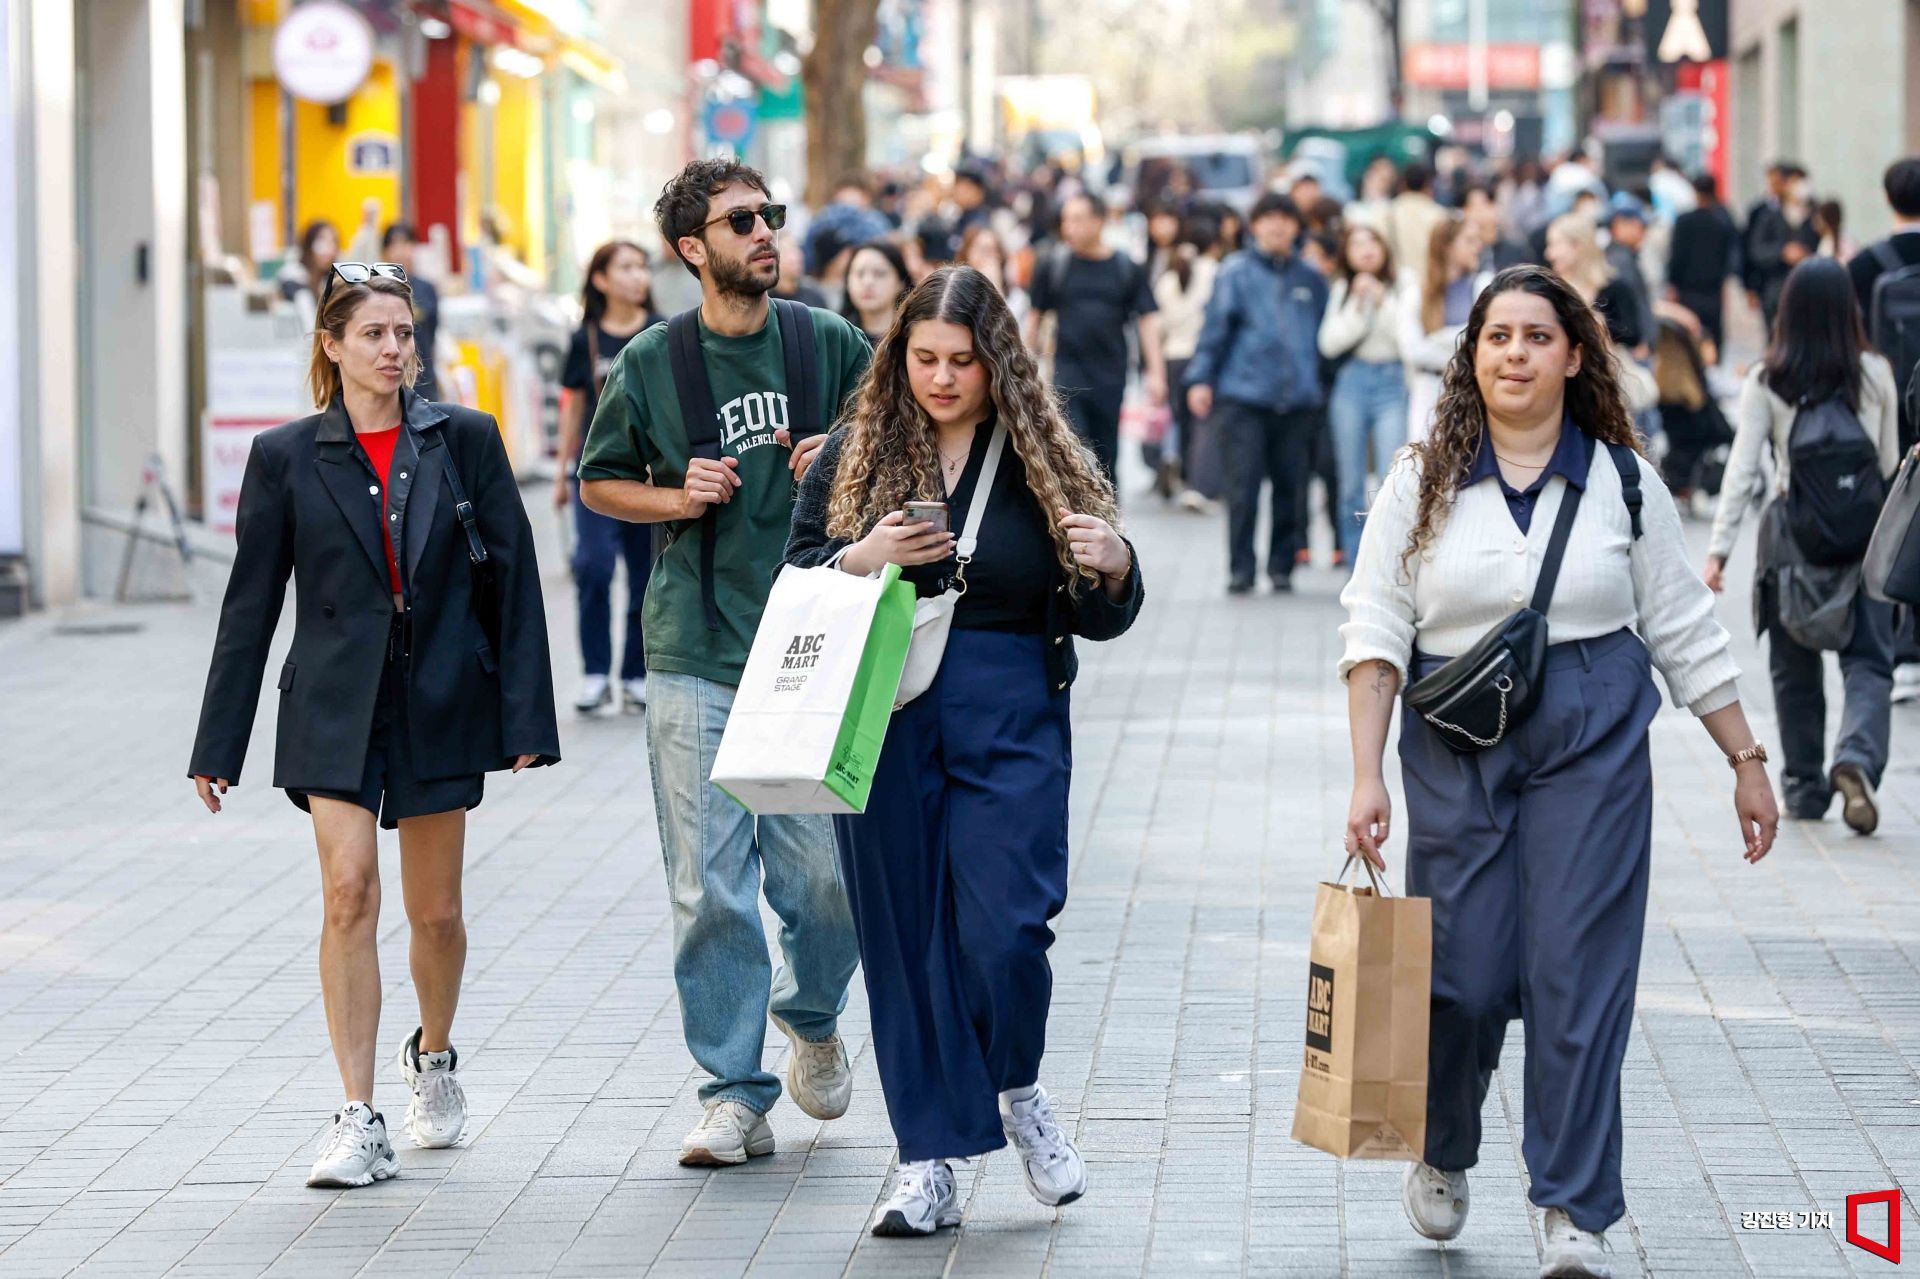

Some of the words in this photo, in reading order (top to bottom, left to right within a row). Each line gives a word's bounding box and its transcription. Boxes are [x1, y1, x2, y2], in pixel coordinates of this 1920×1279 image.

[716, 391, 790, 449] EOU
[735, 433, 787, 455] BALENCIA
[786, 633, 826, 655] ABC
[781, 655, 820, 669] MART
[774, 684, 803, 692] STAGE
[776, 675, 808, 684] GRAND
[1309, 976, 1331, 1013] ABC
[1308, 1010, 1330, 1037] MART
